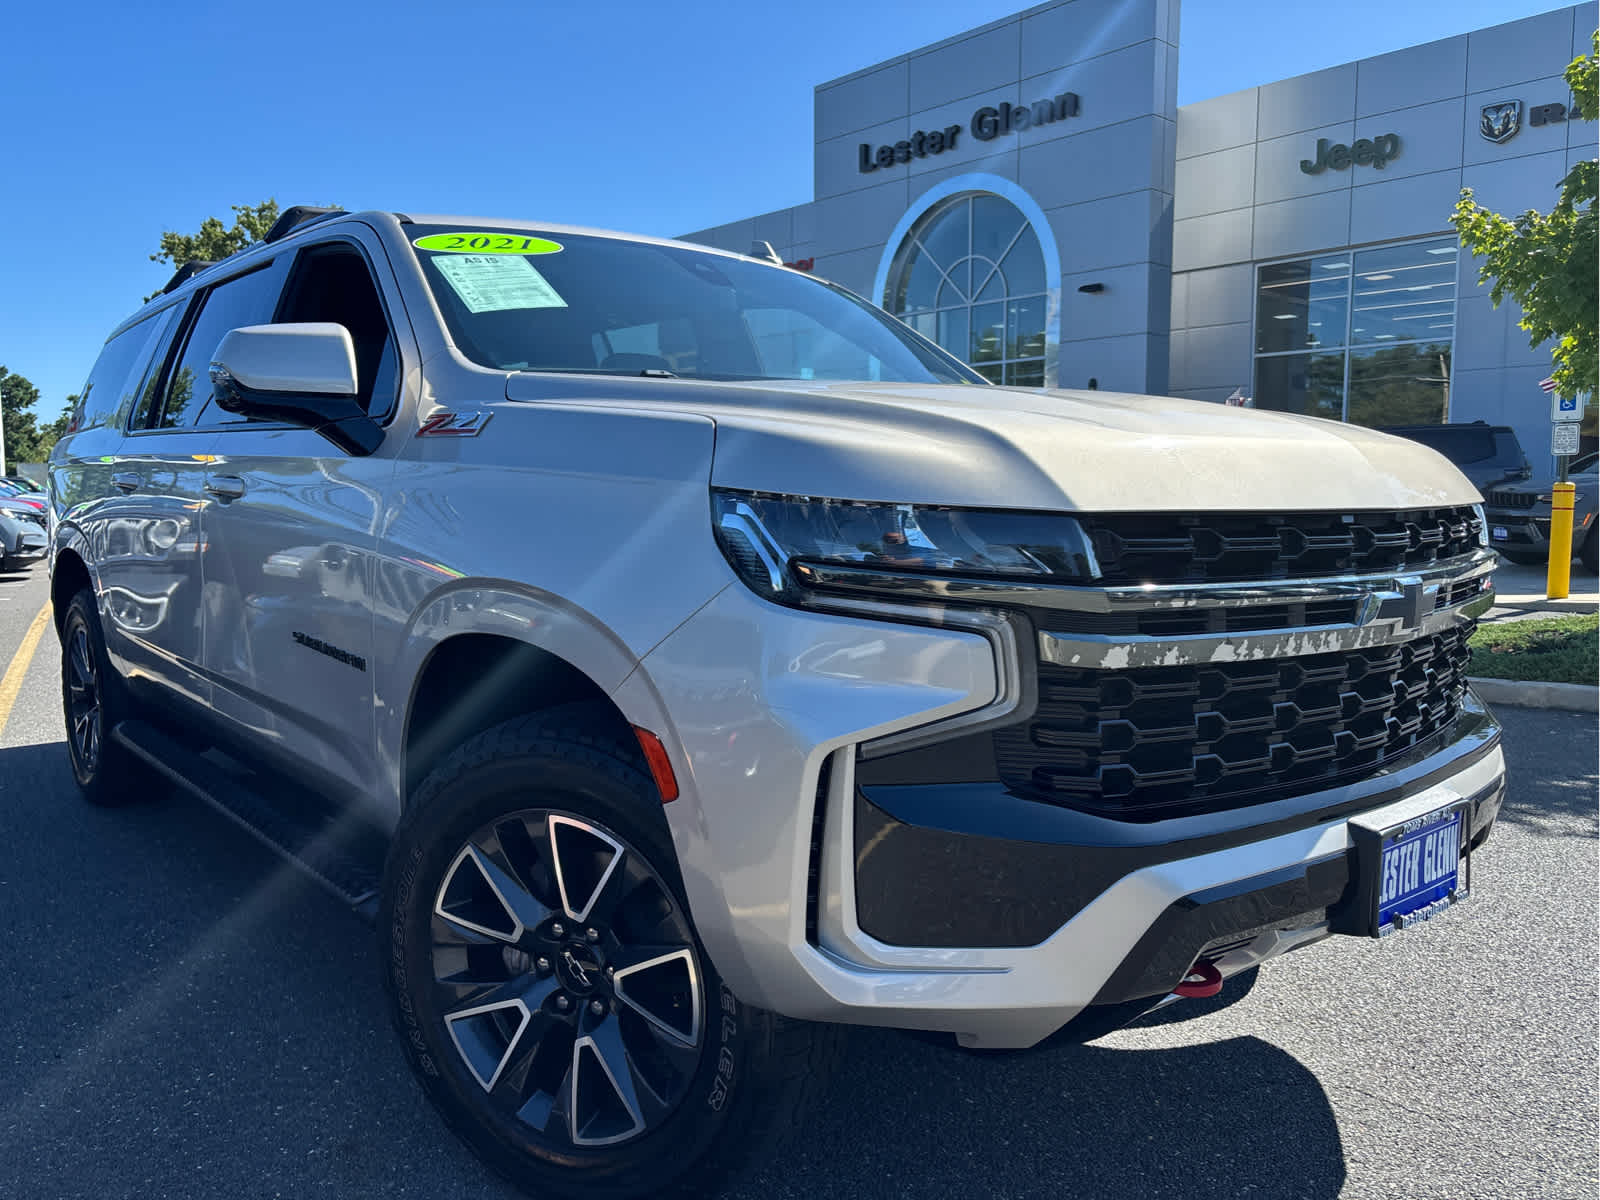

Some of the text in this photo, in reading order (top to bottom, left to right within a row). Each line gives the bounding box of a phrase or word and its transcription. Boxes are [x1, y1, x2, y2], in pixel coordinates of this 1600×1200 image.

[859, 92, 1080, 173] Lester Glenn
[1300, 133, 1400, 174] Jeep
[445, 237, 533, 250] 2021
[1380, 823, 1458, 905] ESTER GLENN
[708, 993, 737, 1111] ELER
